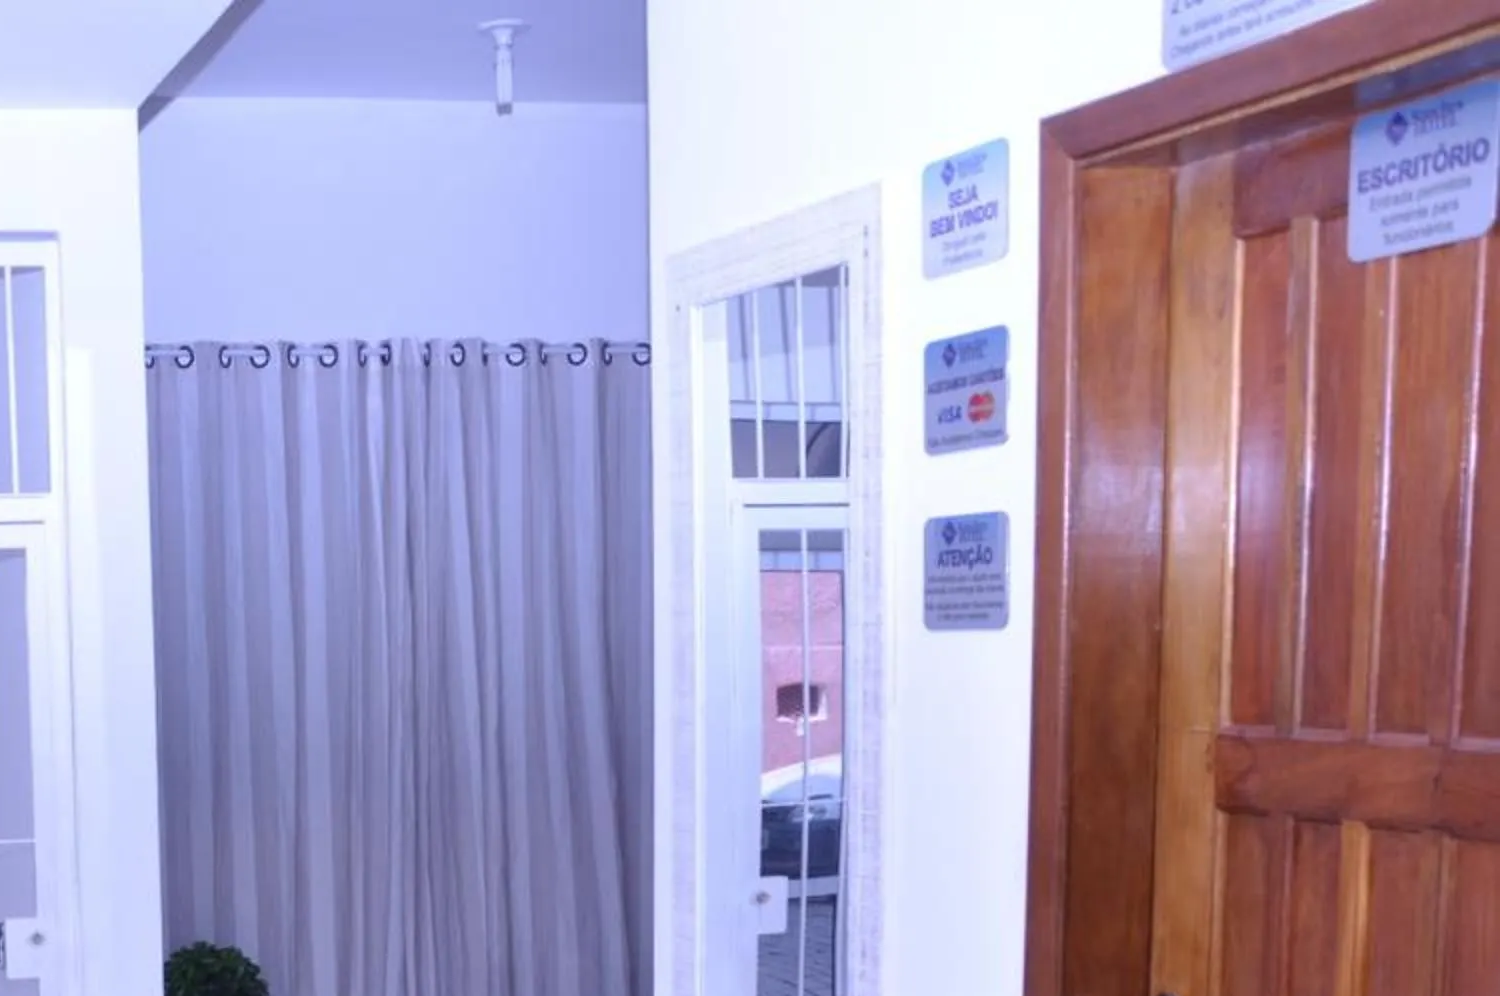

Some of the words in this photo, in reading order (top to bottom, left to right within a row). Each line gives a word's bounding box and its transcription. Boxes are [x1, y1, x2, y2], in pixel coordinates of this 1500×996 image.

[1357, 137, 1490, 194] ESCRITÓRIO
[948, 184, 978, 209] SEJA
[930, 215, 955, 238] BEM
[938, 544, 993, 571] ATENÇÃO
